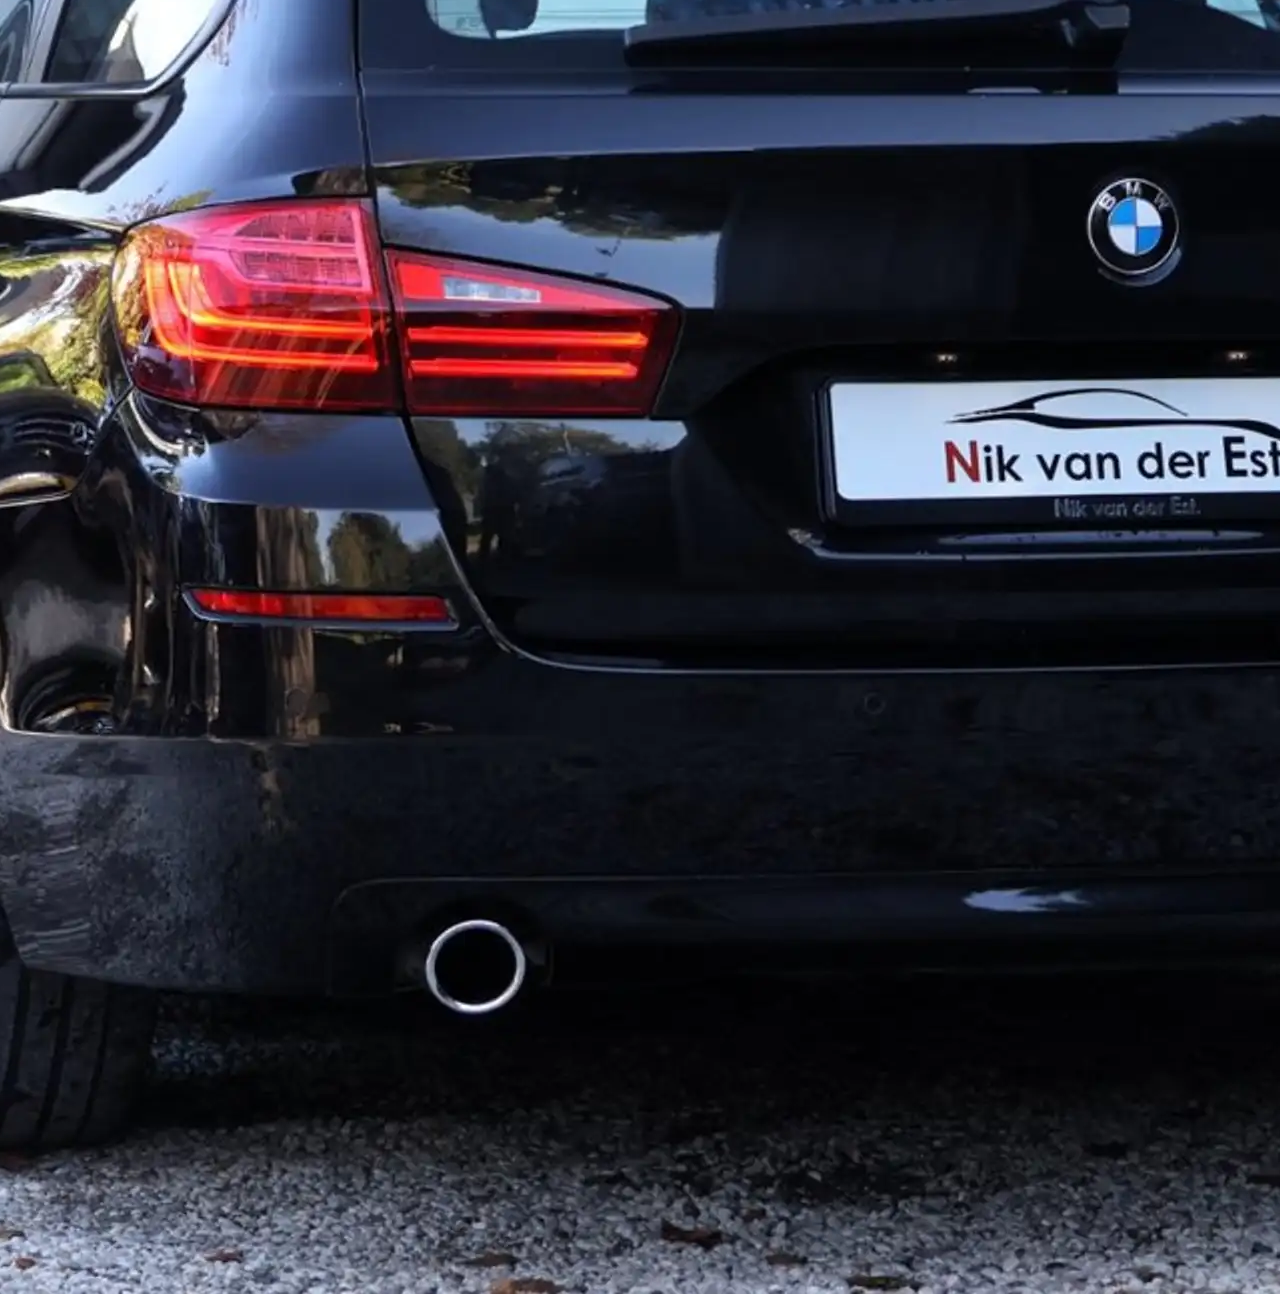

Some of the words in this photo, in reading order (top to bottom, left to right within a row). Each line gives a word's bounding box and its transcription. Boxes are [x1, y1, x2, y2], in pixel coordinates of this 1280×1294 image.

[1097, 180, 1172, 212] BMW
[943, 439, 1024, 483] Nik
[1035, 450, 1122, 481] van
[1136, 441, 1212, 479] der
[1053, 497, 1087, 518] Nik
[1092, 501, 1128, 518] van
[1132, 499, 1165, 517] der
